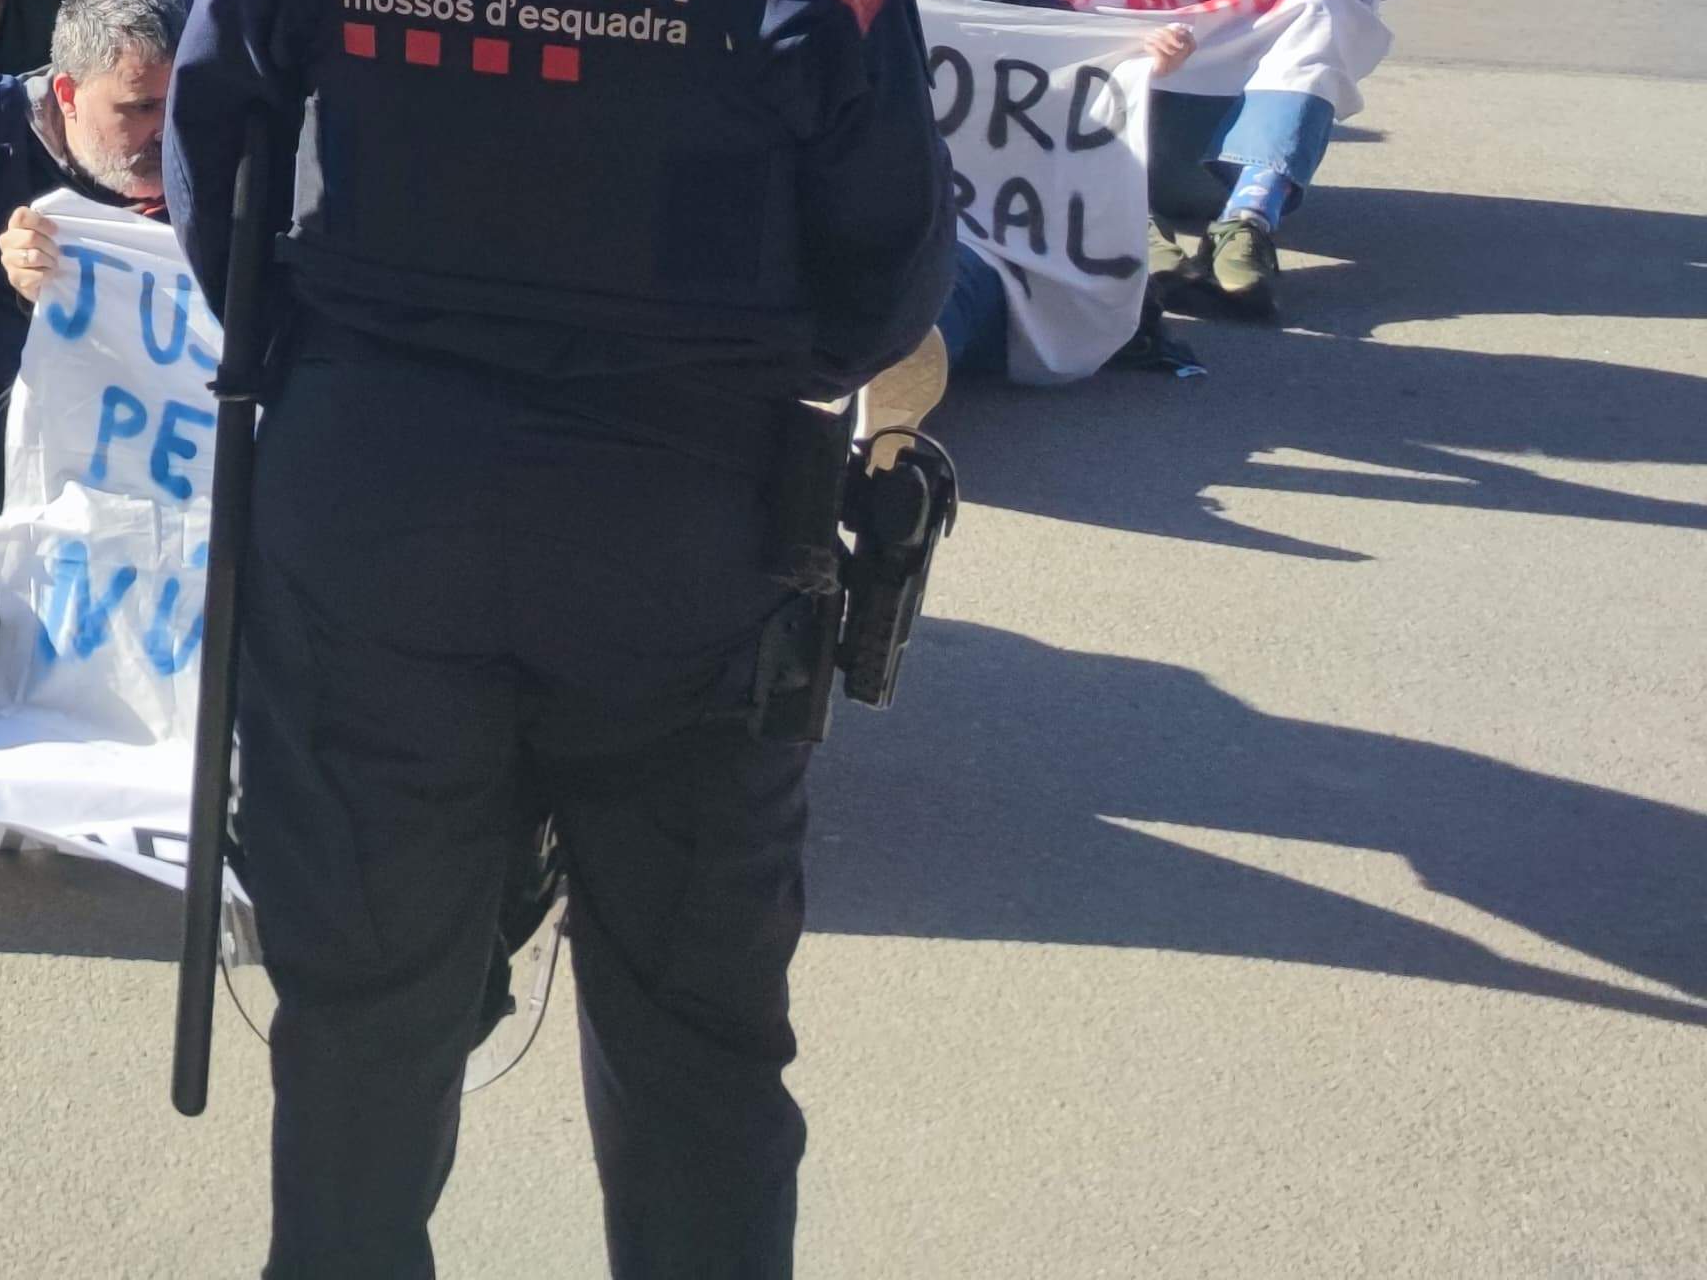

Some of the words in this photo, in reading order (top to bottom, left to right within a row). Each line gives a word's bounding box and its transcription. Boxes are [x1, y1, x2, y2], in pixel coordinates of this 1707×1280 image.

[929, 44, 1129, 153] ORD
[951, 169, 1142, 280] RAL
[88, 384, 216, 501] PE
